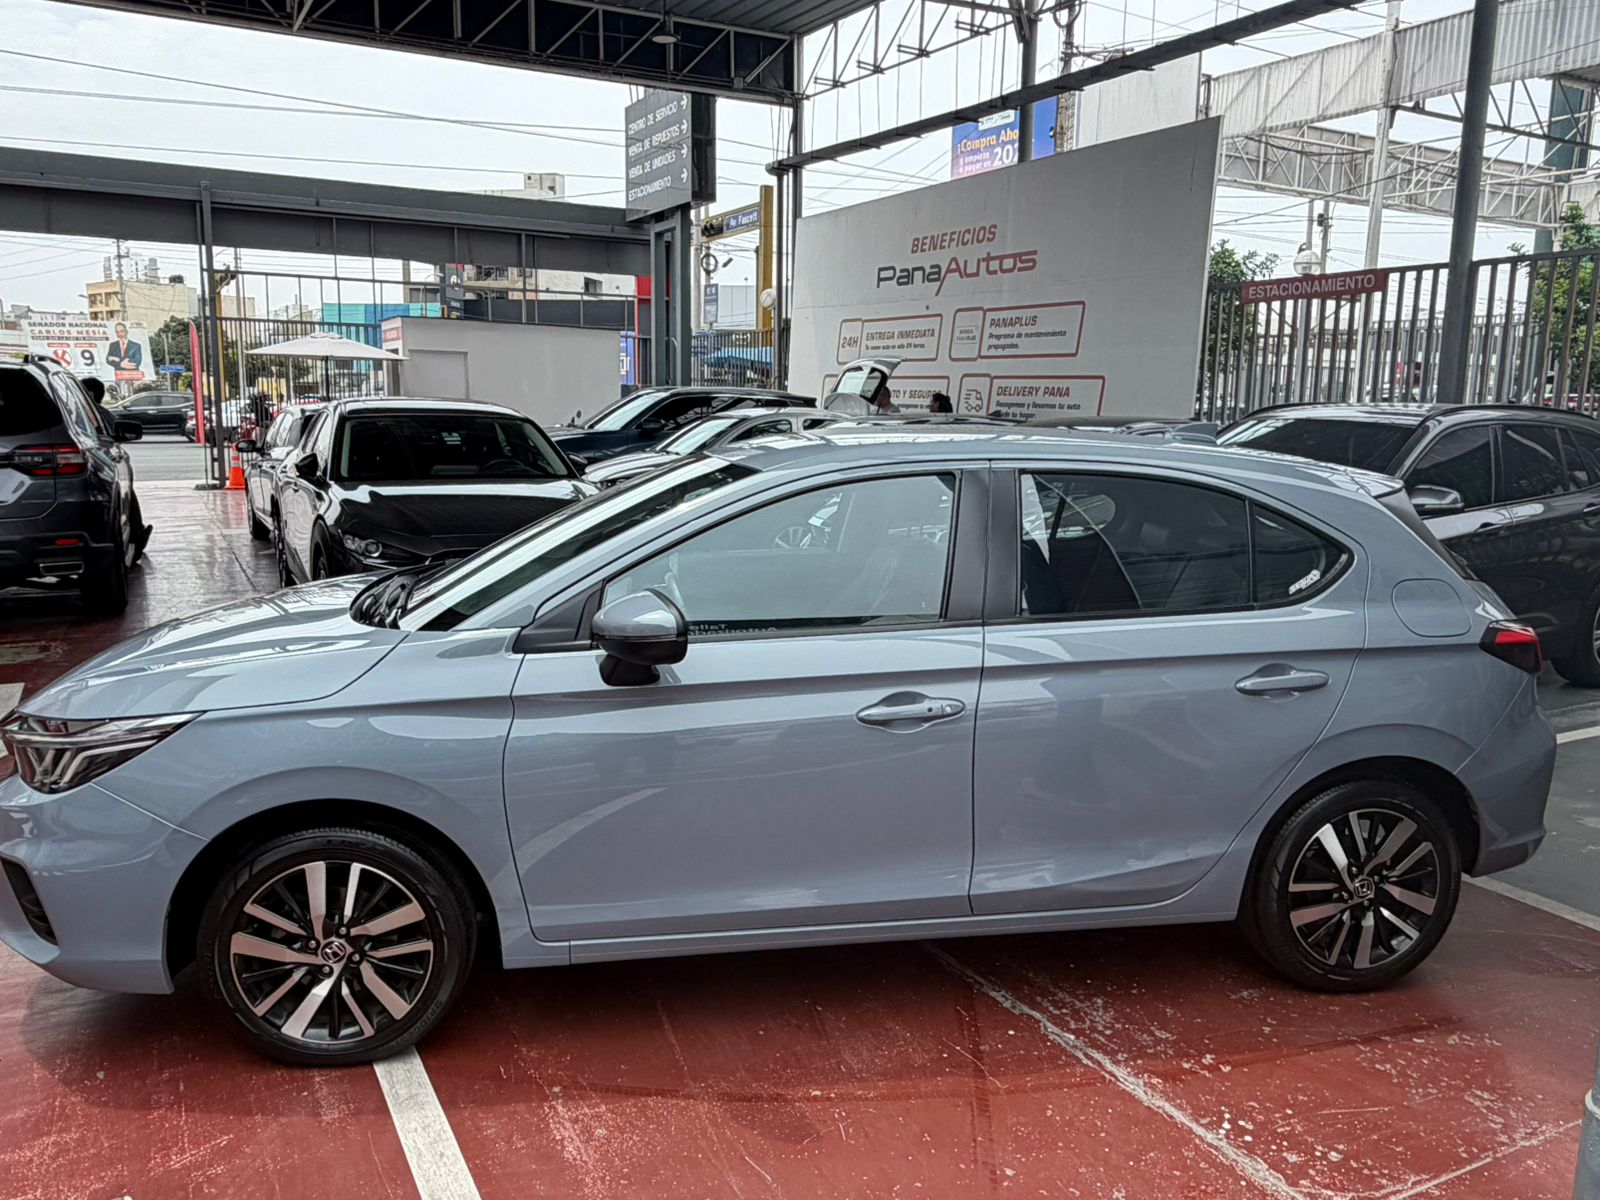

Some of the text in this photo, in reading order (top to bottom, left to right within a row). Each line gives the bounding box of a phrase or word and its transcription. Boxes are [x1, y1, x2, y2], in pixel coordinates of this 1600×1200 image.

[628, 100, 678, 136] CENTRO DE SERVICIO
[628, 124, 680, 157] VENTA DE REPUESTOS
[957, 133, 997, 154] ¡Compra
[628, 150, 676, 180] VENTA DE UNIDADES
[628, 175, 672, 202] ESTACIONAMIENTO
[738, 211, 758, 226] Faucett
[911, 224, 998, 254] BENEFICIOS
[876, 250, 1038, 296] PanaAutos
[1250, 274, 1375, 299] ESTACIONAMIENTO
[989, 315, 1038, 329] PANAPLUS
[841, 336, 859, 349] 24H
[866, 328, 936, 342] ENTREGA INMEDIATA
[988, 332, 1015, 342] Programa
[1016, 331, 1023, 339] de
[80, 349, 96, 366] 9
[902, 390, 908, 398] Y
[996, 386, 1070, 398] DELIVERY PANA
